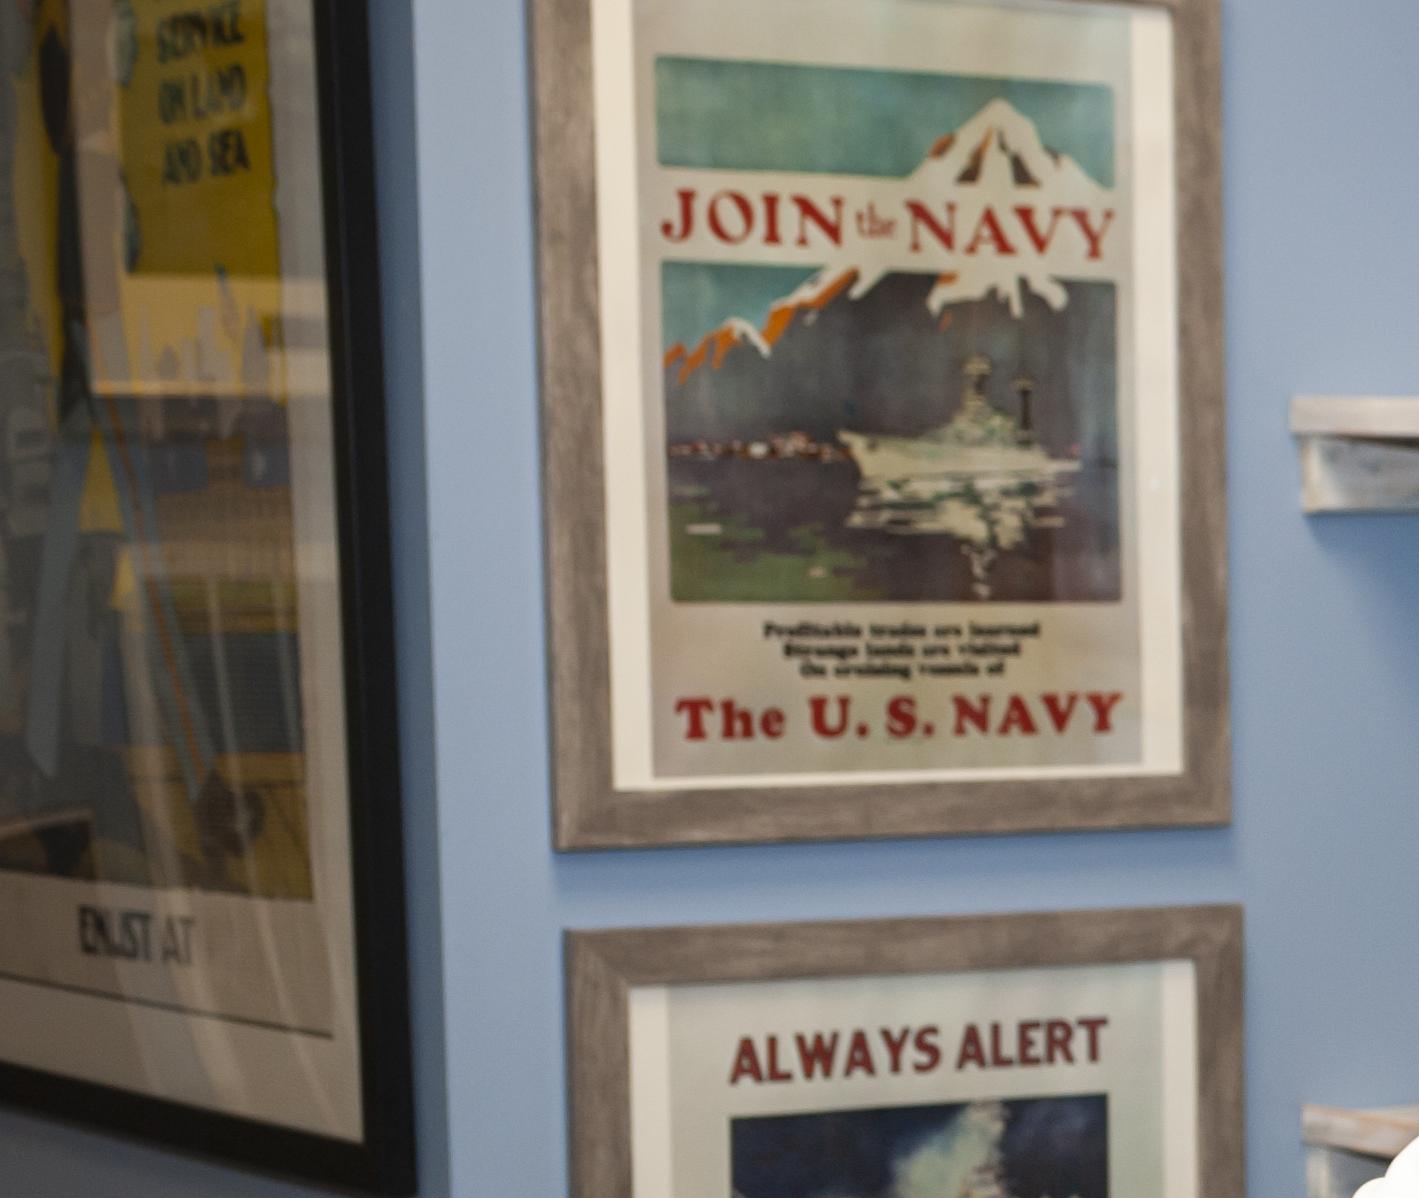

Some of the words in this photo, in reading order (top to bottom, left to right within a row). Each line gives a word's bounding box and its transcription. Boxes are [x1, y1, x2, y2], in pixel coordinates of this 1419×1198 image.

[207, 129, 251, 177] SEA
[661, 189, 844, 248] JOIN
[856, 203, 896, 239] the
[906, 199, 1115, 260] NAVY
[784, 643, 858, 660] Strange
[866, 642, 914, 656] lands
[922, 645, 949, 656] are
[869, 623, 926, 637] trades
[934, 626, 962, 637] are
[970, 622, 1040, 637] learned
[800, 661, 826, 677] the
[987, 661, 1006, 674] of
[676, 697, 785, 741] The
[953, 692, 1123, 735] NAVY
[78, 904, 153, 961] ENLIST
[161, 917, 196, 965] AT
[729, 1026, 942, 1086] ALWAYS
[956, 1016, 1109, 1070] ALERT
